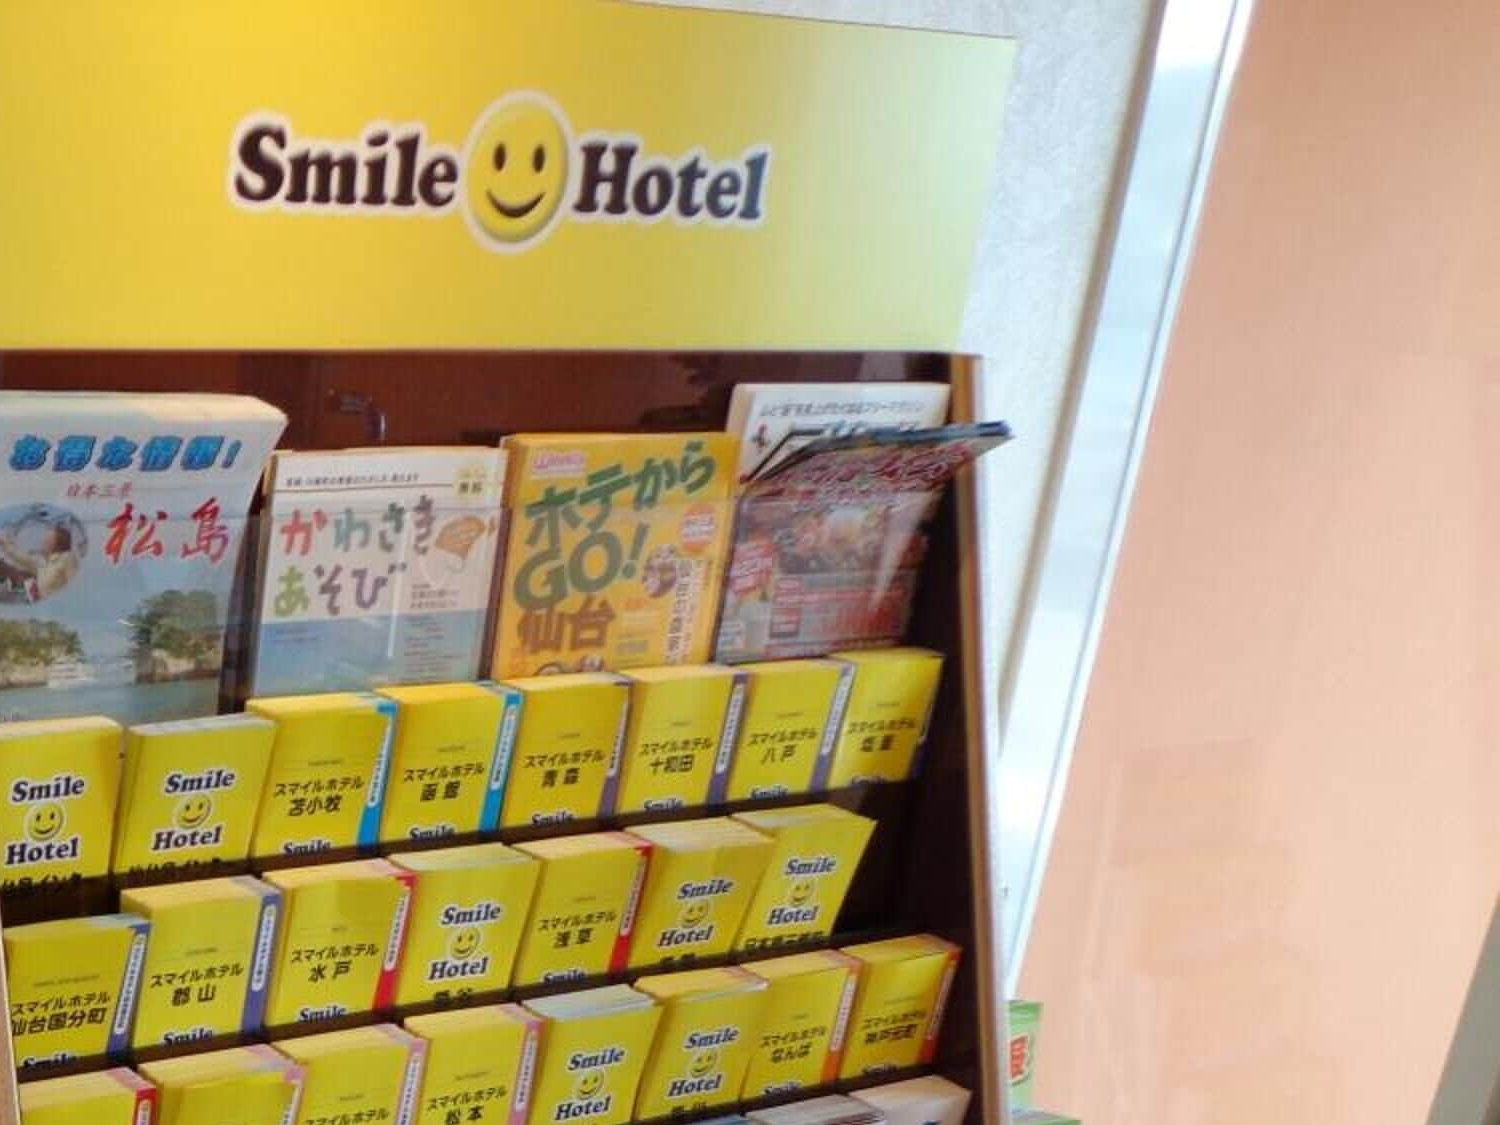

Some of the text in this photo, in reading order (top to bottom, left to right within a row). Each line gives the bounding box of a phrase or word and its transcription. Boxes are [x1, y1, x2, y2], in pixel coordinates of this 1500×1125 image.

[235, 124, 769, 221] Smile Hotel
[105, 497, 231, 564] 松島
[514, 522, 651, 609] GO!
[639, 738, 715, 758] スマイルホテル
[746, 727, 818, 747] スマイルホテル
[523, 748, 606, 770] スマイルホテル
[647, 754, 695, 774] 十和田
[163, 769, 236, 795] Smile
[404, 762, 485, 785] スマイルホテル
[11, 776, 86, 803] Smile
[275, 776, 365, 798] スマイルホテル
[151, 826, 222, 852] Hotel
[5, 838, 79, 866] Hotel
[785, 857, 837, 876] Smile
[677, 880, 733, 900] Smile
[440, 904, 502, 926] Smile
[538, 909, 617, 932] スマイルホテル
[767, 905, 819, 925] Hotel
[657, 926, 715, 947] Hotel
[290, 942, 380, 965] スマイルホテル
[150, 963, 244, 988] スマイルホテル
[307, 960, 353, 983] 水戸
[428, 957, 488, 980] Hotel
[11, 990, 112, 1017] スマイルホテル
[298, 1005, 347, 1023] Smile
[684, 1027, 740, 1049] Smile
[760, 1025, 828, 1047] スマイルホテル
[567, 1048, 625, 1072] Smile
[426, 1085, 508, 1111] スマイルホテル
[667, 1075, 723, 1098] Hotel
[554, 1097, 612, 1121] Hotel
